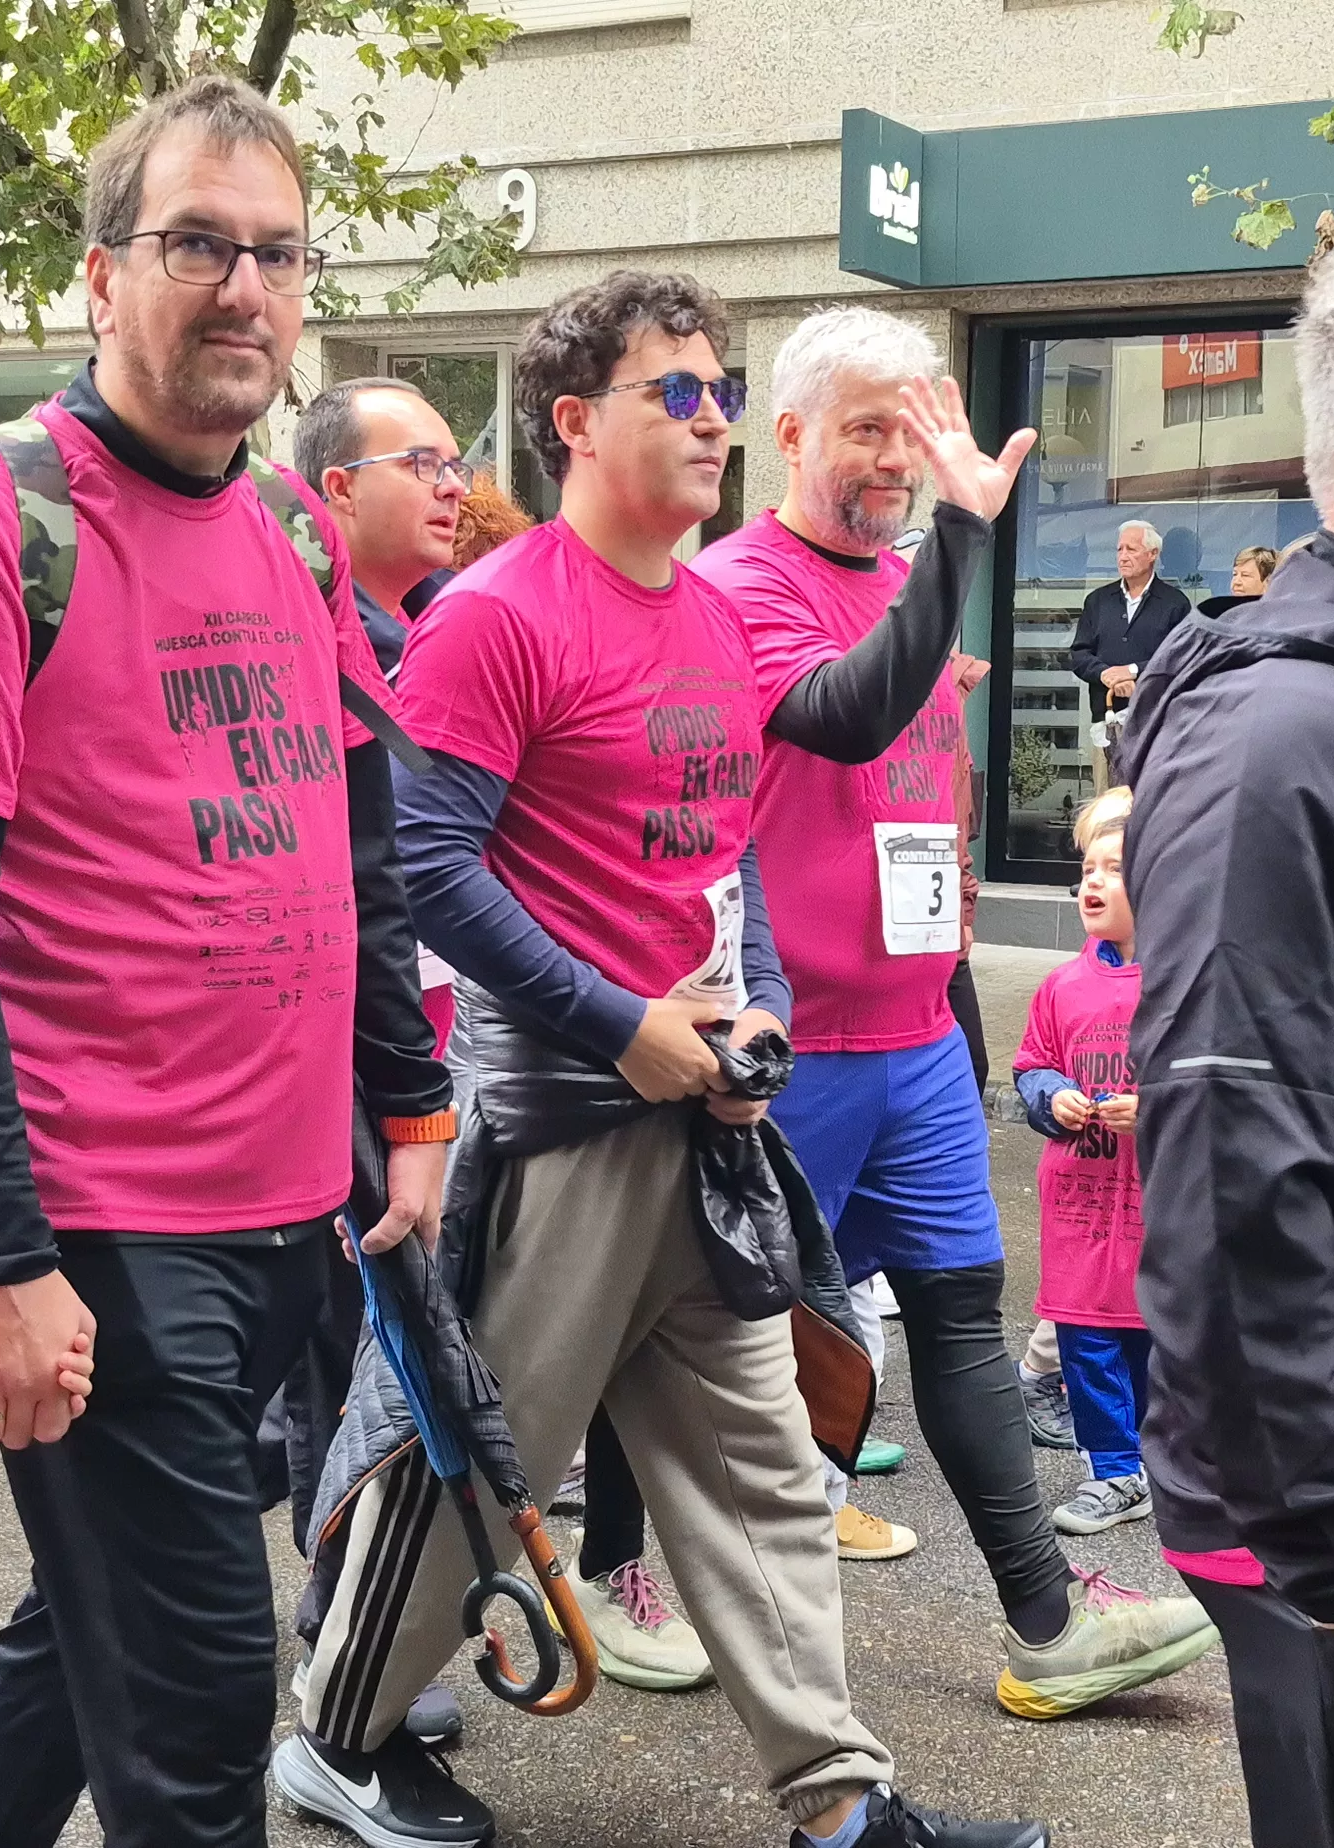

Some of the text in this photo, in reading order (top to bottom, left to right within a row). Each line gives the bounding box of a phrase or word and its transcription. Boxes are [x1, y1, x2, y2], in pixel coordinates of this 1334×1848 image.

[498, 168, 537, 252] 9
[154, 633, 207, 653] HUESCA
[203, 612, 223, 628] XII
[160, 662, 287, 735] UNIDOS
[885, 758, 939, 806] PASO
[188, 789, 299, 866] PASO
[641, 805, 716, 862] PASO
[928, 870, 944, 917] 3
[1066, 1121, 1118, 1161] ASO
